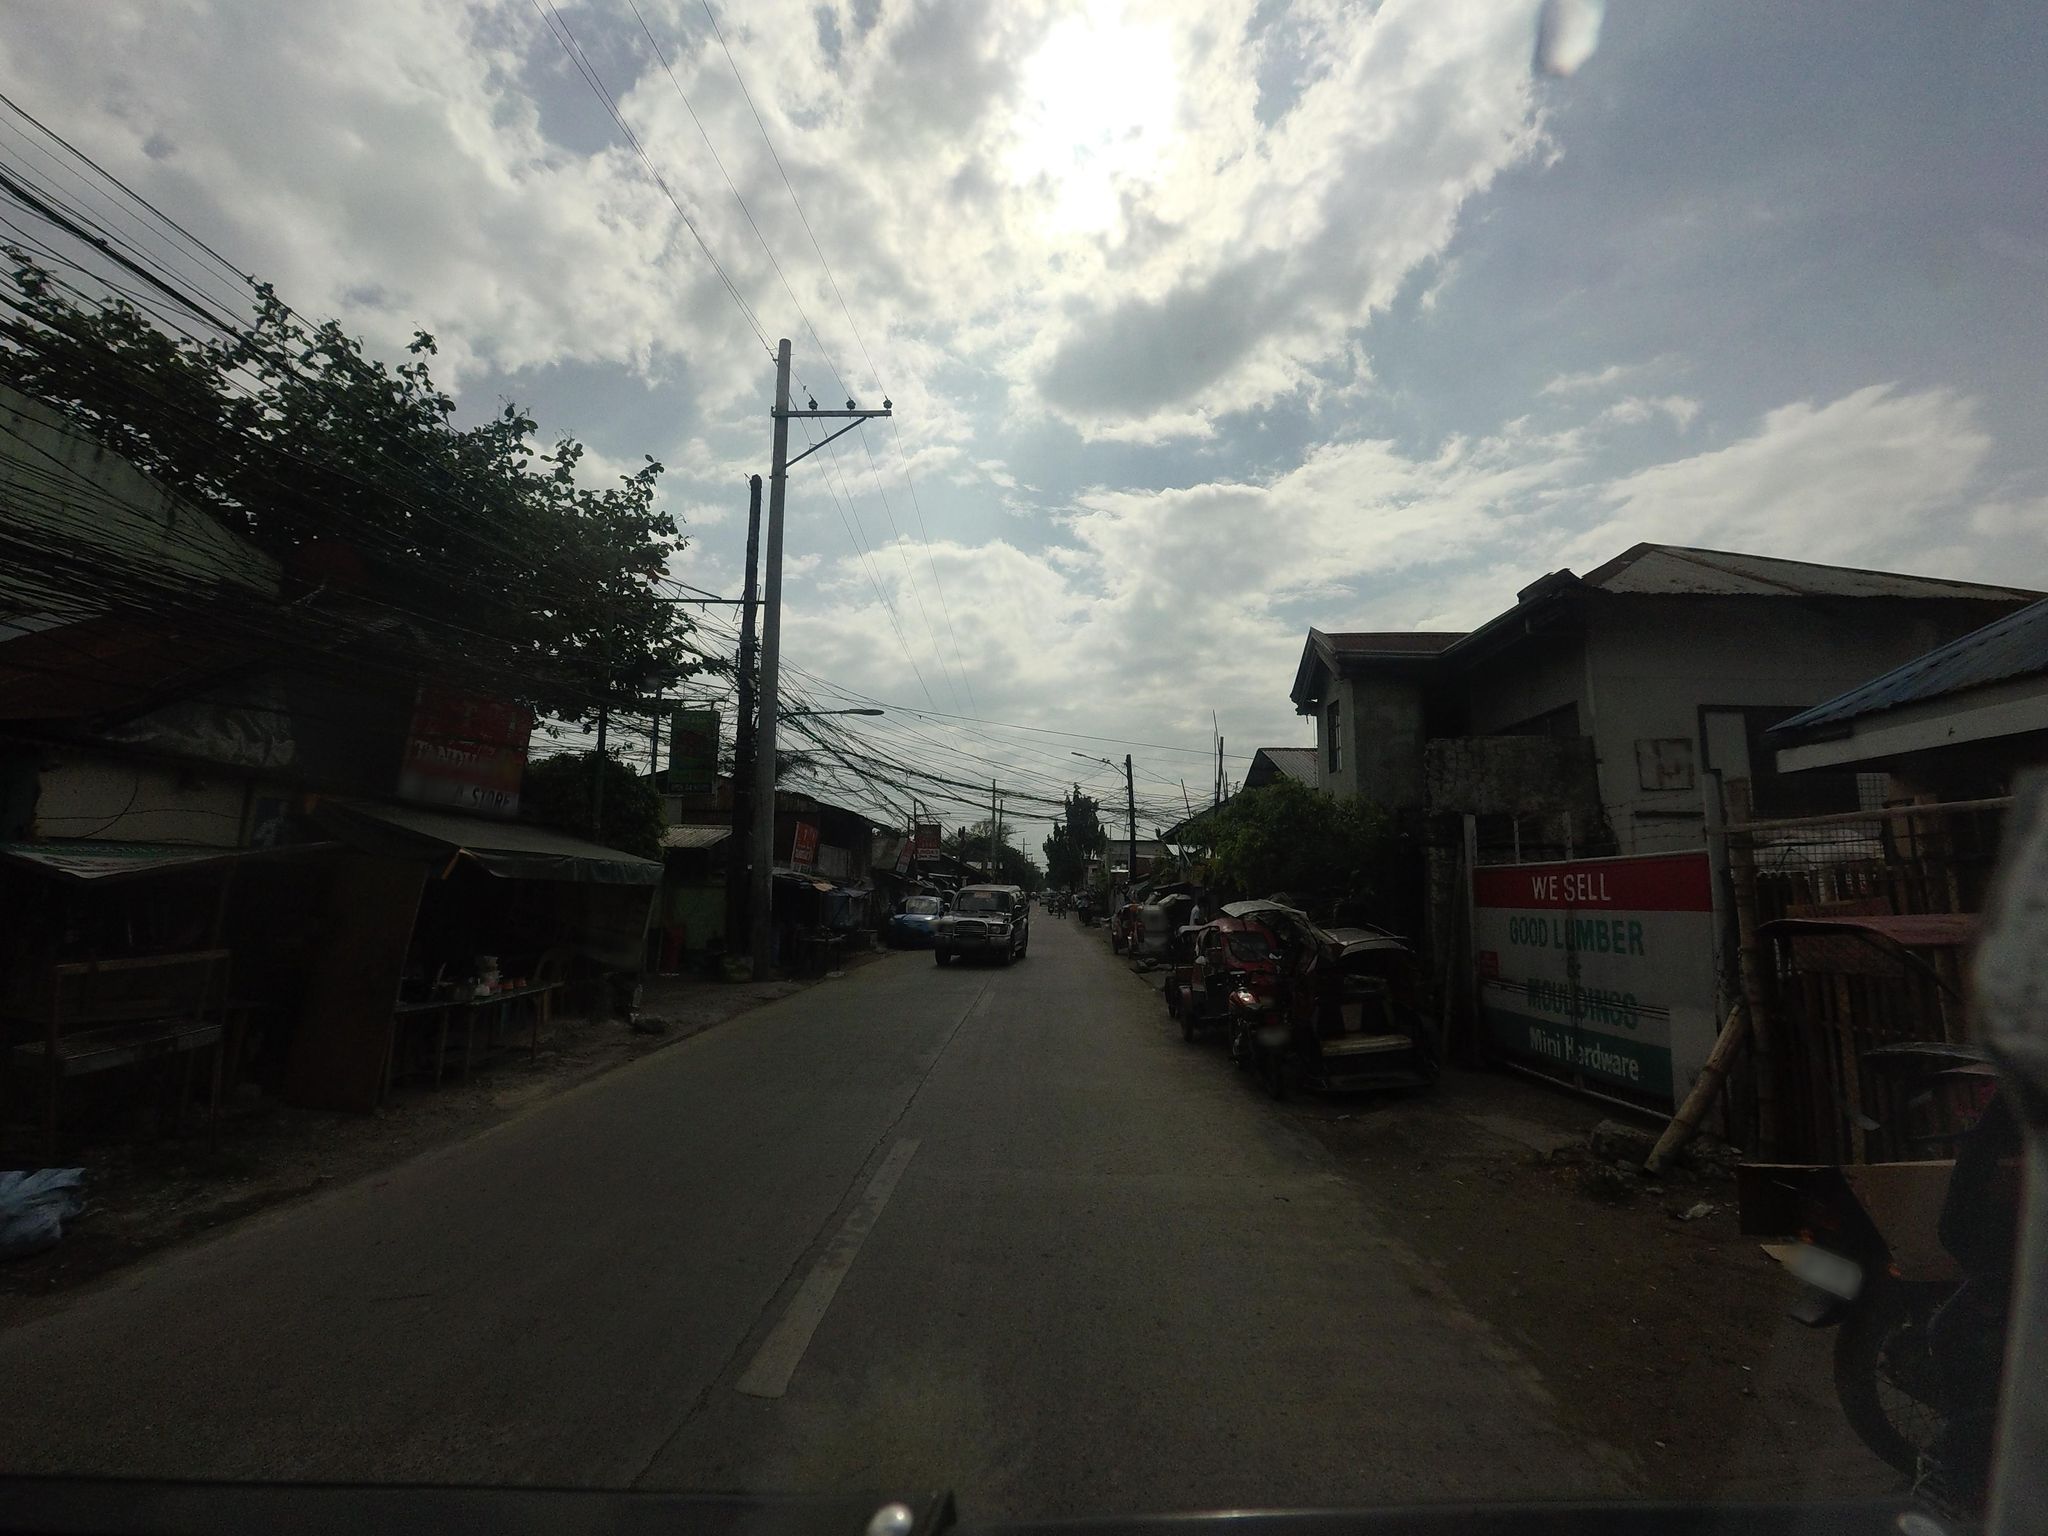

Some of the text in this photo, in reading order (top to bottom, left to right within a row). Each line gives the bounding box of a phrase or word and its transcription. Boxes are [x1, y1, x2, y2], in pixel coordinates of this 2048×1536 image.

[1531, 872, 1612, 902] WE SELL
[1509, 916, 1645, 956] GOOD LUMBER
[1528, 1023, 1640, 1081] Mini Hardware
